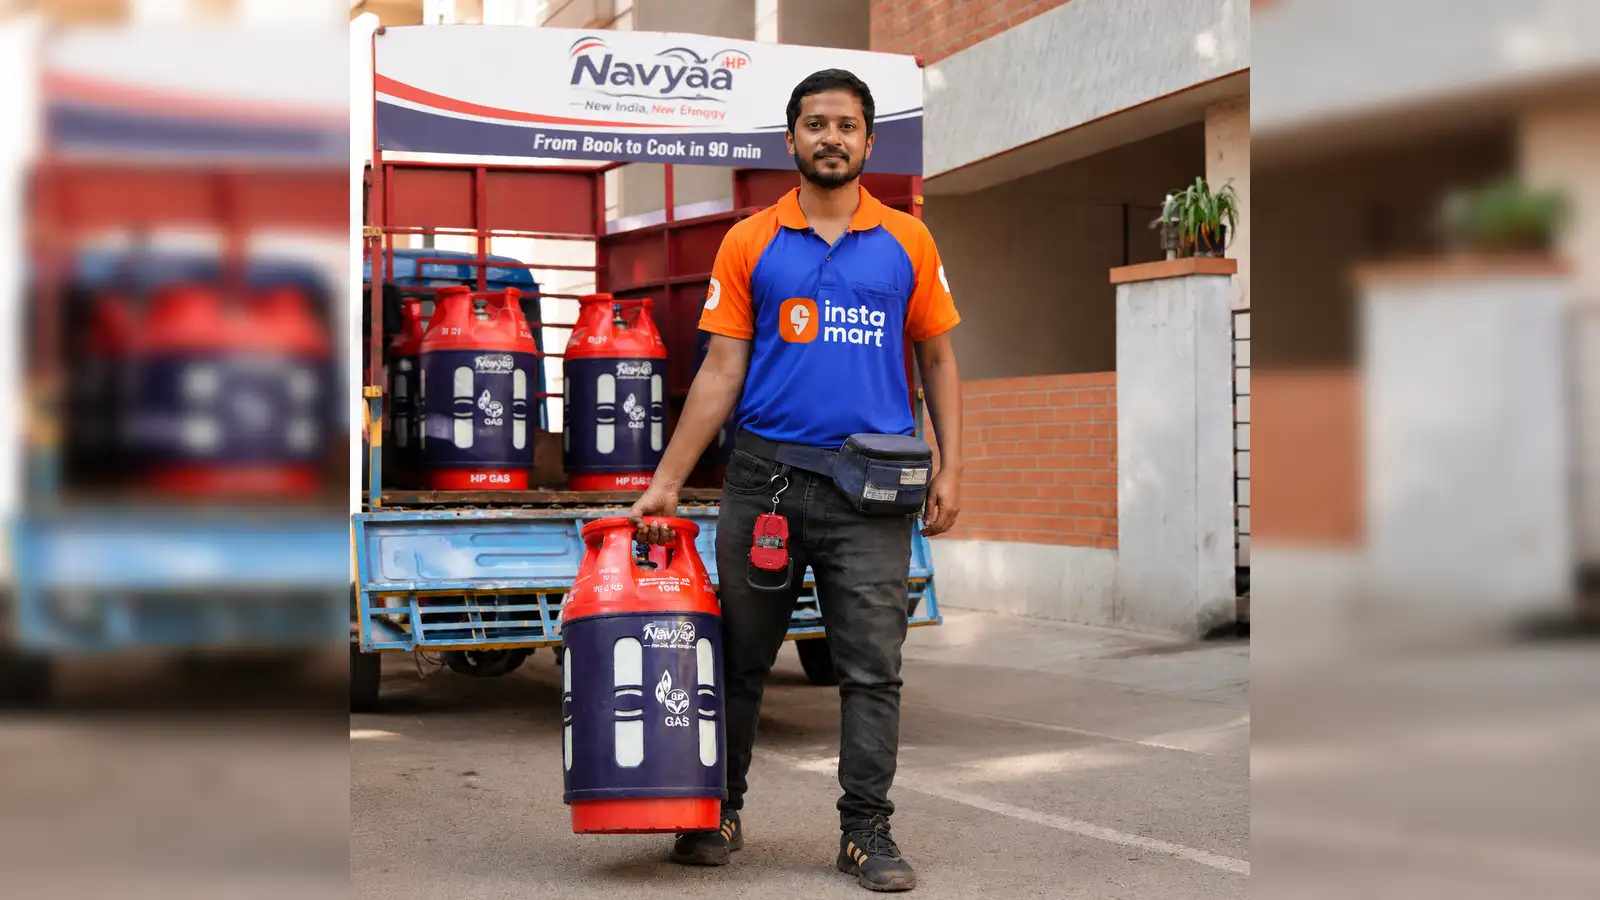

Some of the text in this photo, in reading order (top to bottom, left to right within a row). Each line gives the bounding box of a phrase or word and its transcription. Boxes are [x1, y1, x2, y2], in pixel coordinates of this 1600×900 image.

[726, 57, 748, 69] HP
[584, 101, 612, 111] New
[615, 102, 649, 114] India,
[533, 133, 762, 159] From Book to Cook in 90 min
[824, 299, 886, 327] insta
[823, 326, 884, 347] mart
[470, 474, 510, 483] HP GAS
[615, 477, 630, 485] HP
[665, 716, 690, 727] GAS
